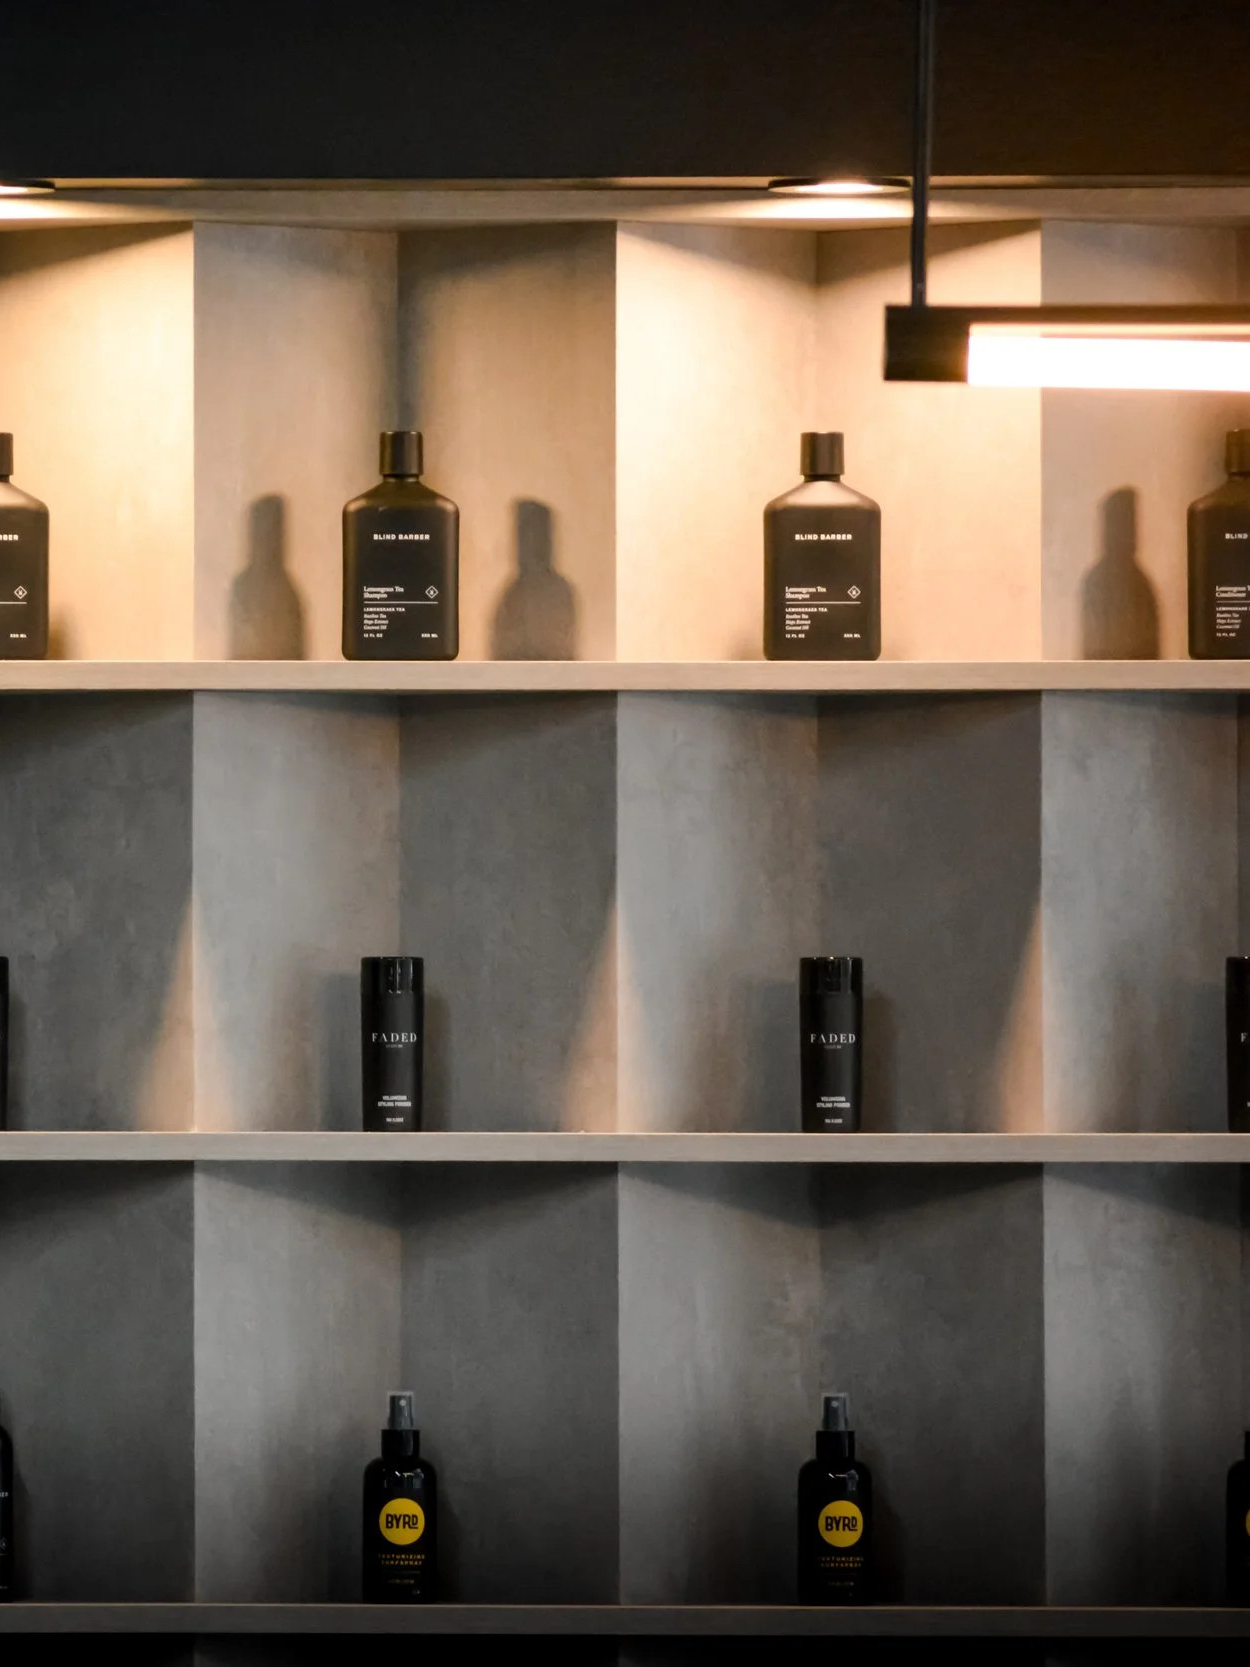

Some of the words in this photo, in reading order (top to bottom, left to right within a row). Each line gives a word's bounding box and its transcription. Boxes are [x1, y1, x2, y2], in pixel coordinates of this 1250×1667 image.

[372, 1032, 417, 1042] FADED
[810, 1033, 856, 1043] FADED
[386, 1514, 418, 1529] BYRD
[825, 1516, 857, 1531] BYRD
